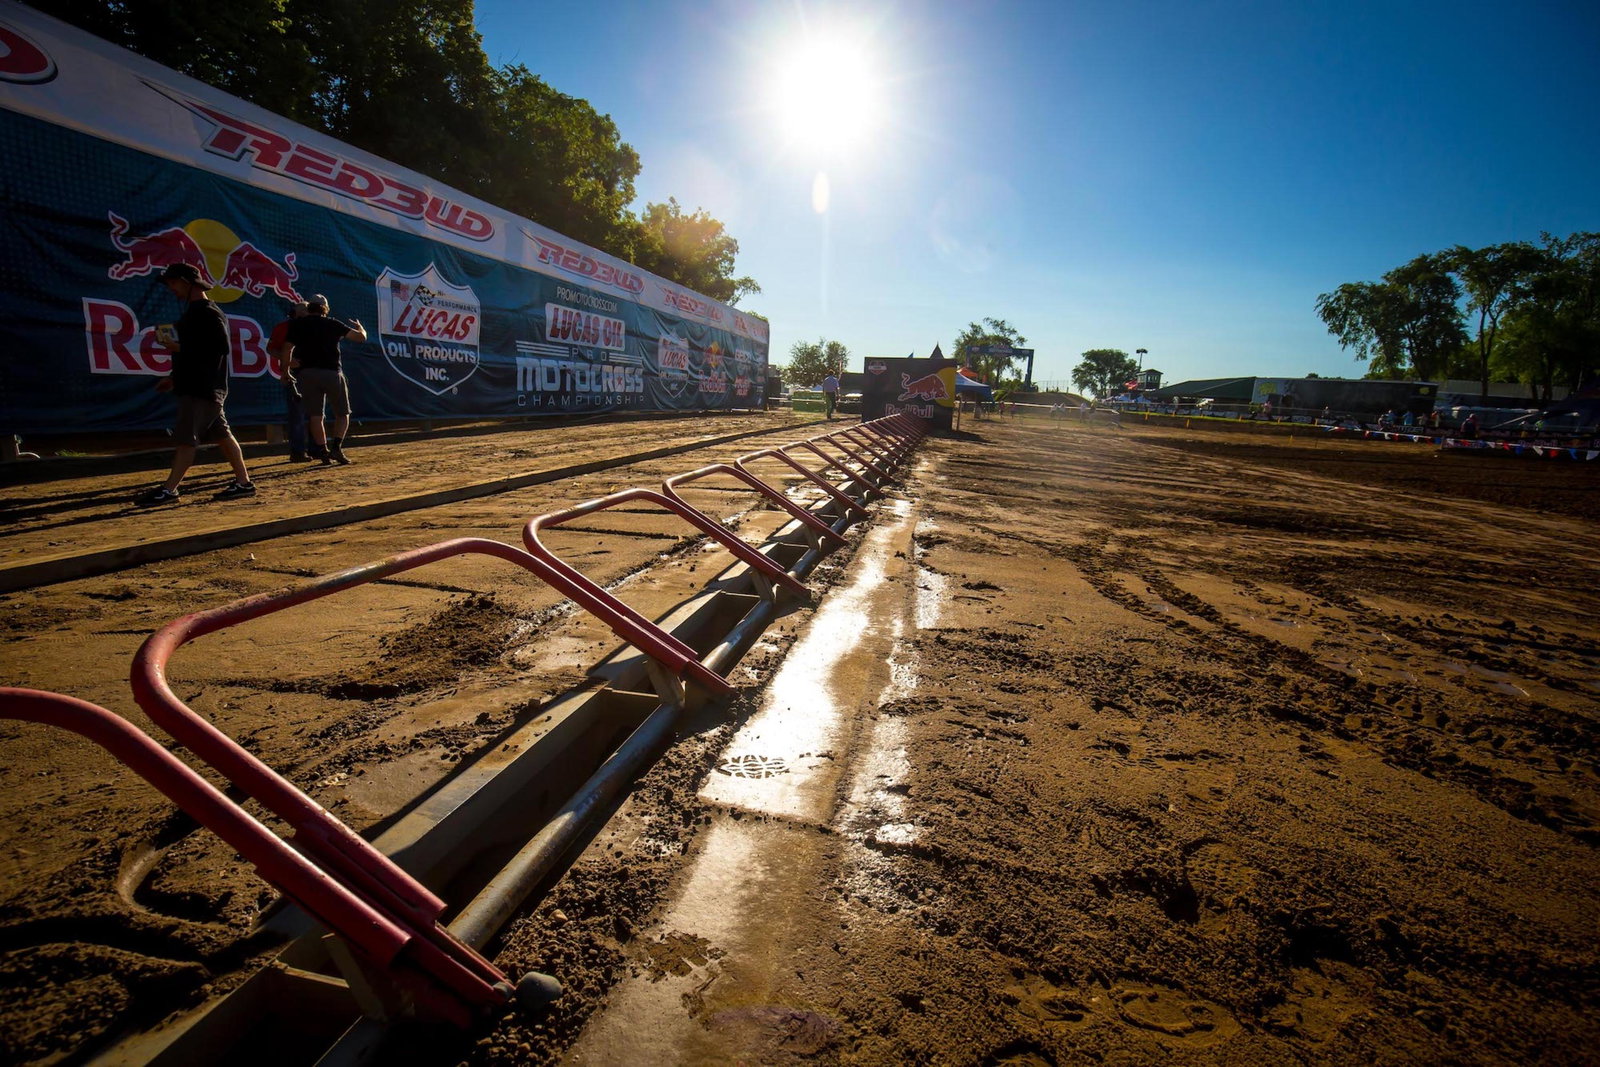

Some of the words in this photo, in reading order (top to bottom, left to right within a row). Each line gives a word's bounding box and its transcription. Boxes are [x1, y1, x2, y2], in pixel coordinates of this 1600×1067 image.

[184, 100, 497, 242] REDBUD
[533, 236, 645, 294] REDBUD
[82, 297, 174, 377] Re
[392, 303, 476, 341] LUCAS
[550, 307, 601, 345] LUCAS
[602, 318, 624, 348] OIL
[387, 341, 412, 359] OIL
[415, 344, 477, 364] PRODUCTS
[571, 346, 608, 362] PRO
[425, 366, 450, 381] INC.
[515, 356, 644, 393] MOTOCROSS
[517, 394, 645, 407] CHAMPIONSHIP
